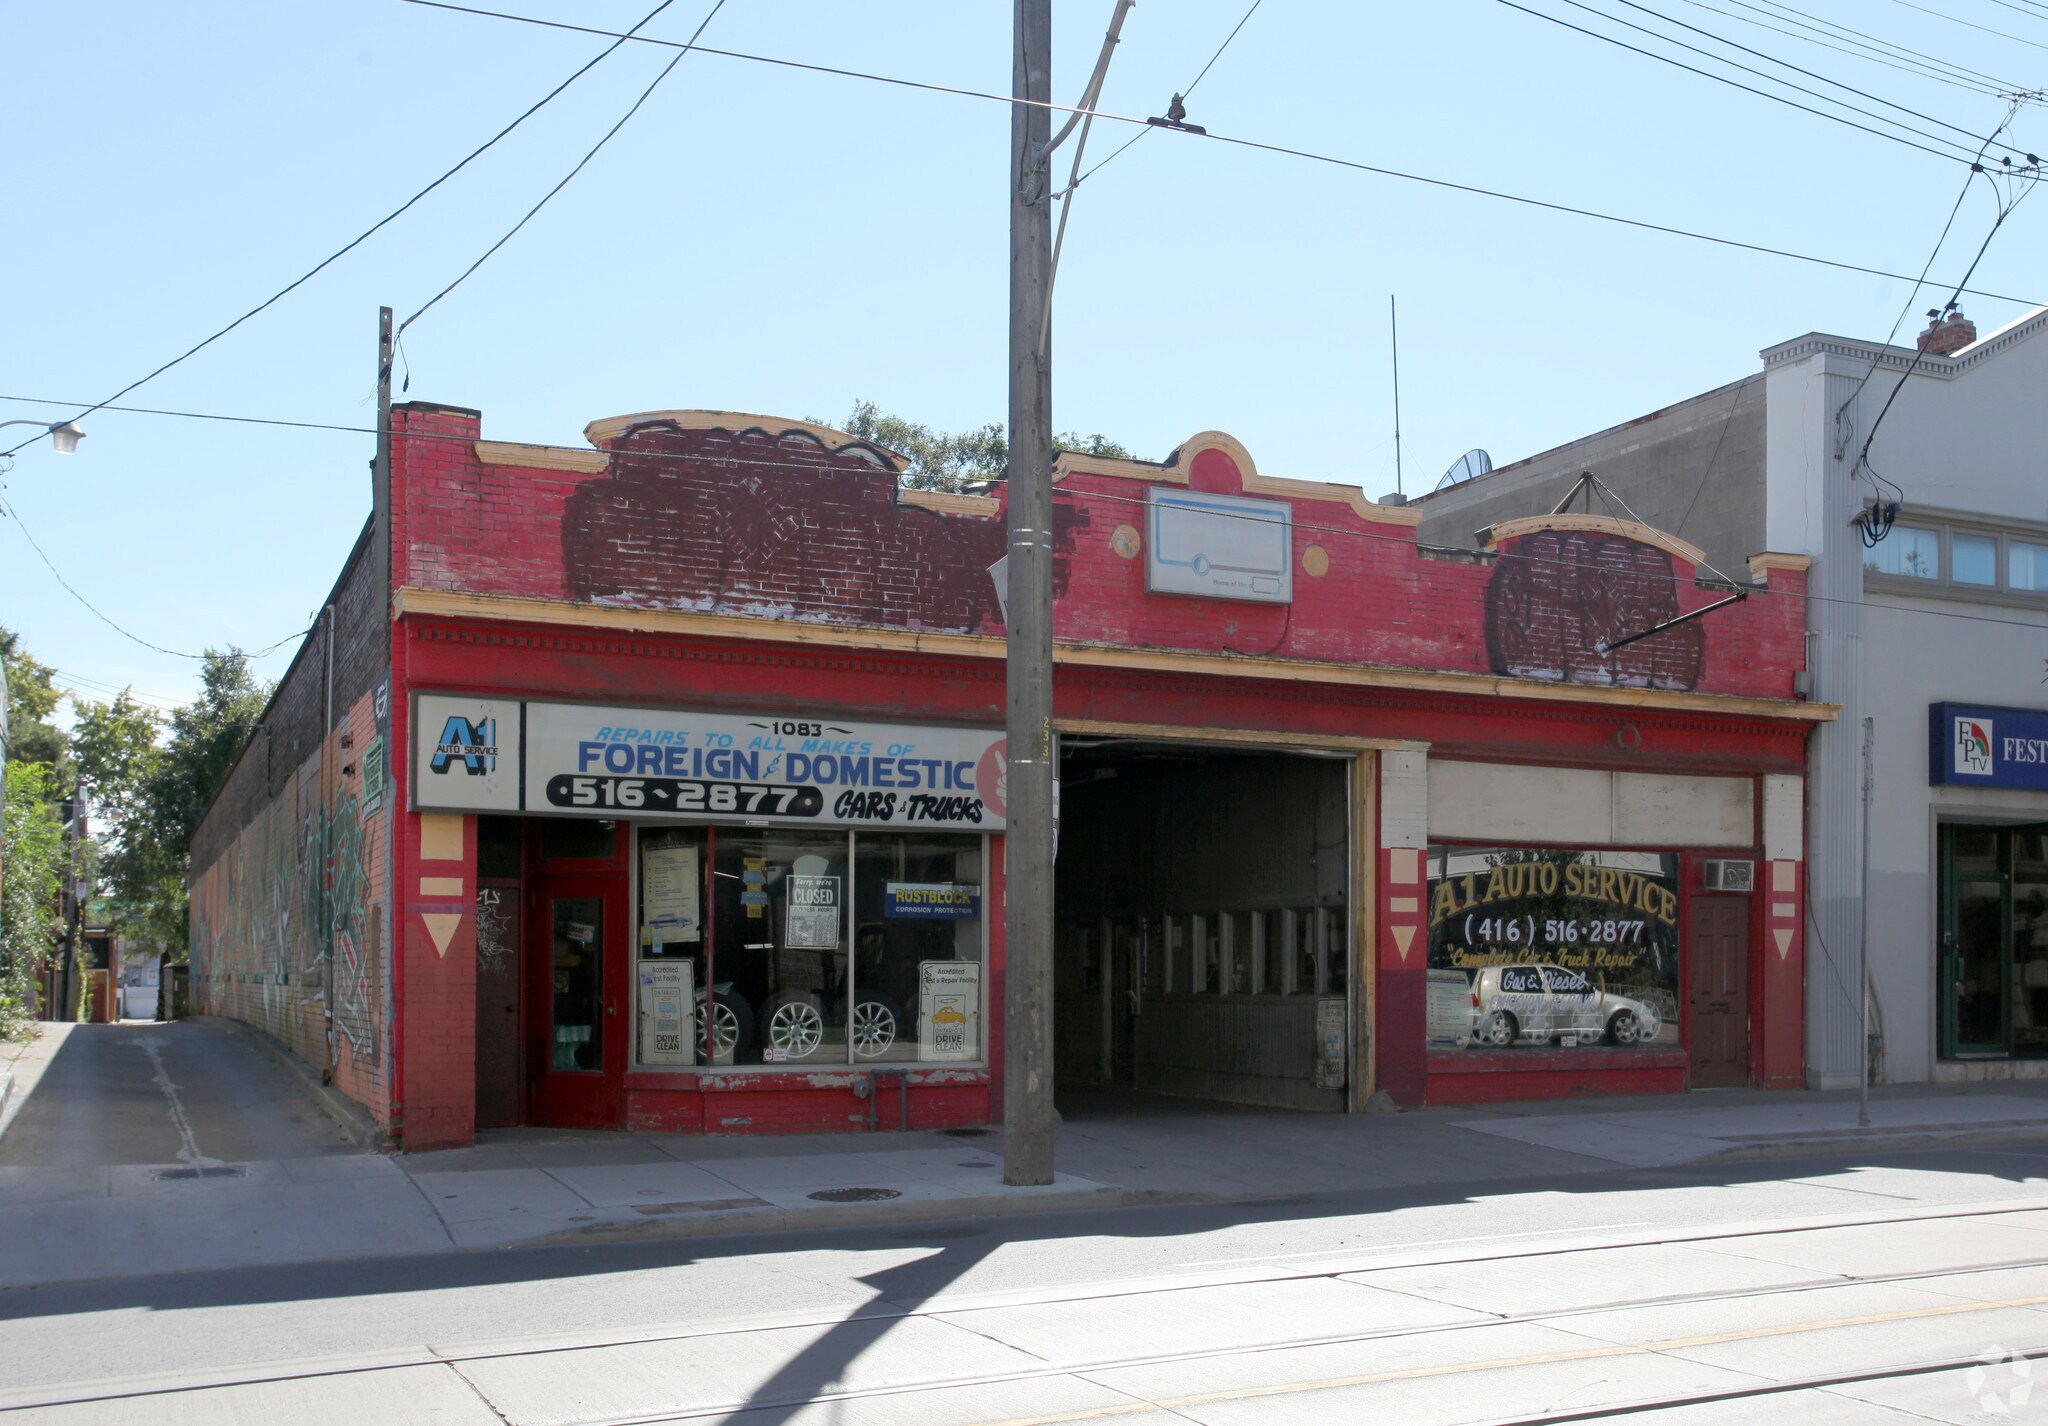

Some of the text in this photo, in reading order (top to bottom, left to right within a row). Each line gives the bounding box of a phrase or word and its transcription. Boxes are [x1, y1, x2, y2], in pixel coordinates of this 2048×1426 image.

[771, 721, 822, 737] 1083
[430, 716, 496, 776] A1
[436, 744, 499, 756] AUTO SERVICE
[595, 727, 916, 757] REPAIRS TO ALL MAKES OF
[2003, 737, 2048, 763] FEST
[578, 741, 760, 781] FOREIGN
[785, 752, 975, 790] DOMESTIC
[833, 789, 897, 822] CARS
[907, 793, 984, 824] TRUCKS
[794, 888, 834, 905] CLOSED
[895, 888, 971, 904] RUSTBLOCK
[1430, 862, 1677, 928] A1 AUTO SERVICE
[895, 906, 932, 914] CORROSION
[1516, 949, 1541, 966] Car
[1543, 951, 1553, 966] &
[1557, 948, 1590, 968] Truck
[652, 966, 679, 974] Accredited
[663, 974, 681, 983] Facility
[940, 977, 958, 985] Repair
[960, 977, 978, 985] Facility
[1503, 970, 1587, 991] Gas & Diesel
[656, 1034, 680, 1043] DRIVE
[935, 1034, 962, 1043] DRIVE
[656, 1043, 680, 1051] CLEAN
[935, 1043, 962, 1052] CLEAN
